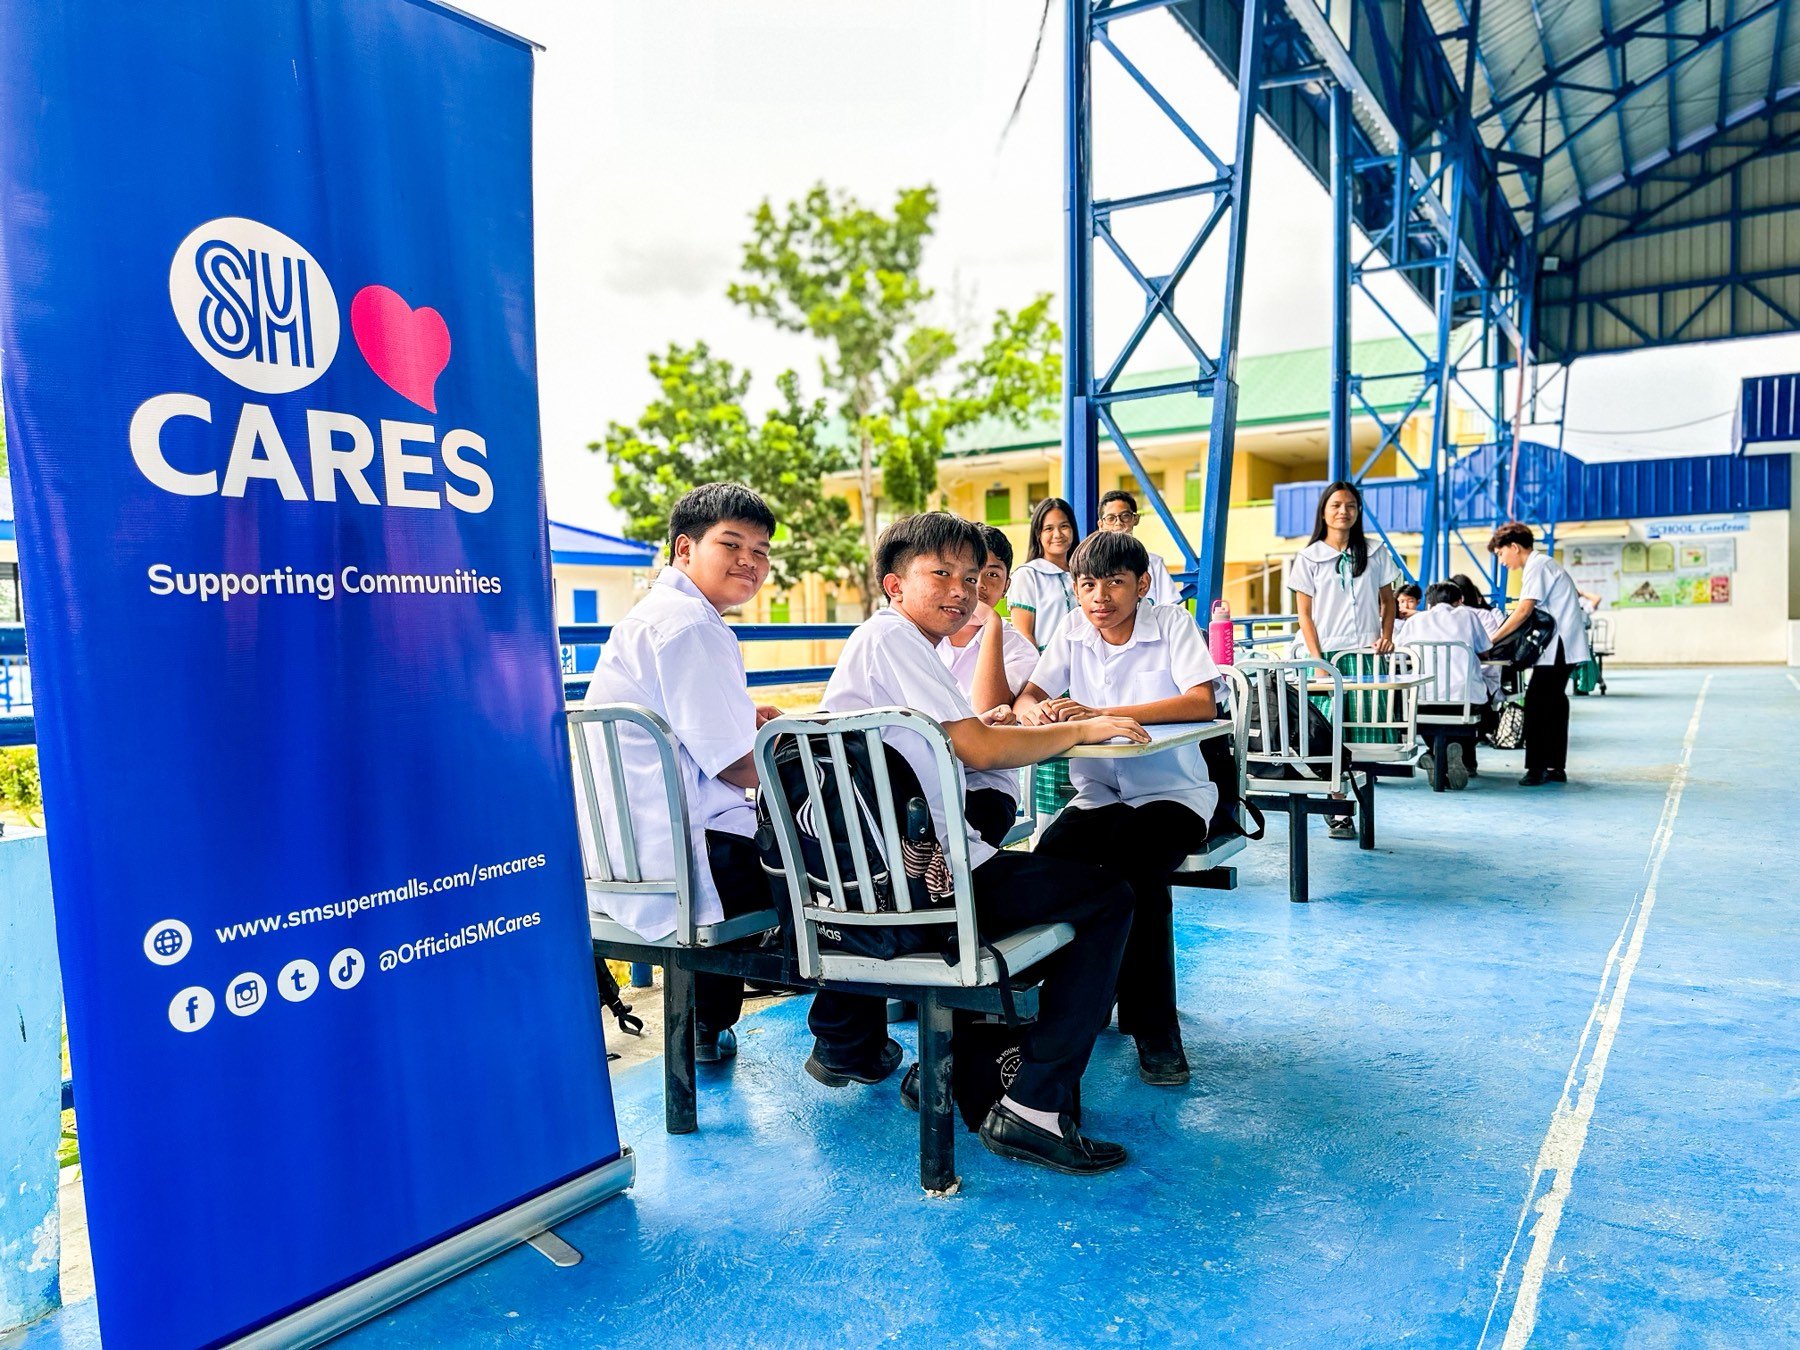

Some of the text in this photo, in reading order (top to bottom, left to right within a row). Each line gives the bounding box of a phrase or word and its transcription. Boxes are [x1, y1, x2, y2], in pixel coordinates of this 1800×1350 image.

[194, 238, 316, 370] SM
[129, 393, 495, 514] CARES
[148, 563, 502, 602] Supporting Communities
[215, 852, 546, 944] www.smsupermalls.com/smcares
[815, 921, 842, 942] idas
[379, 911, 541, 972] @OfficialSMCares
